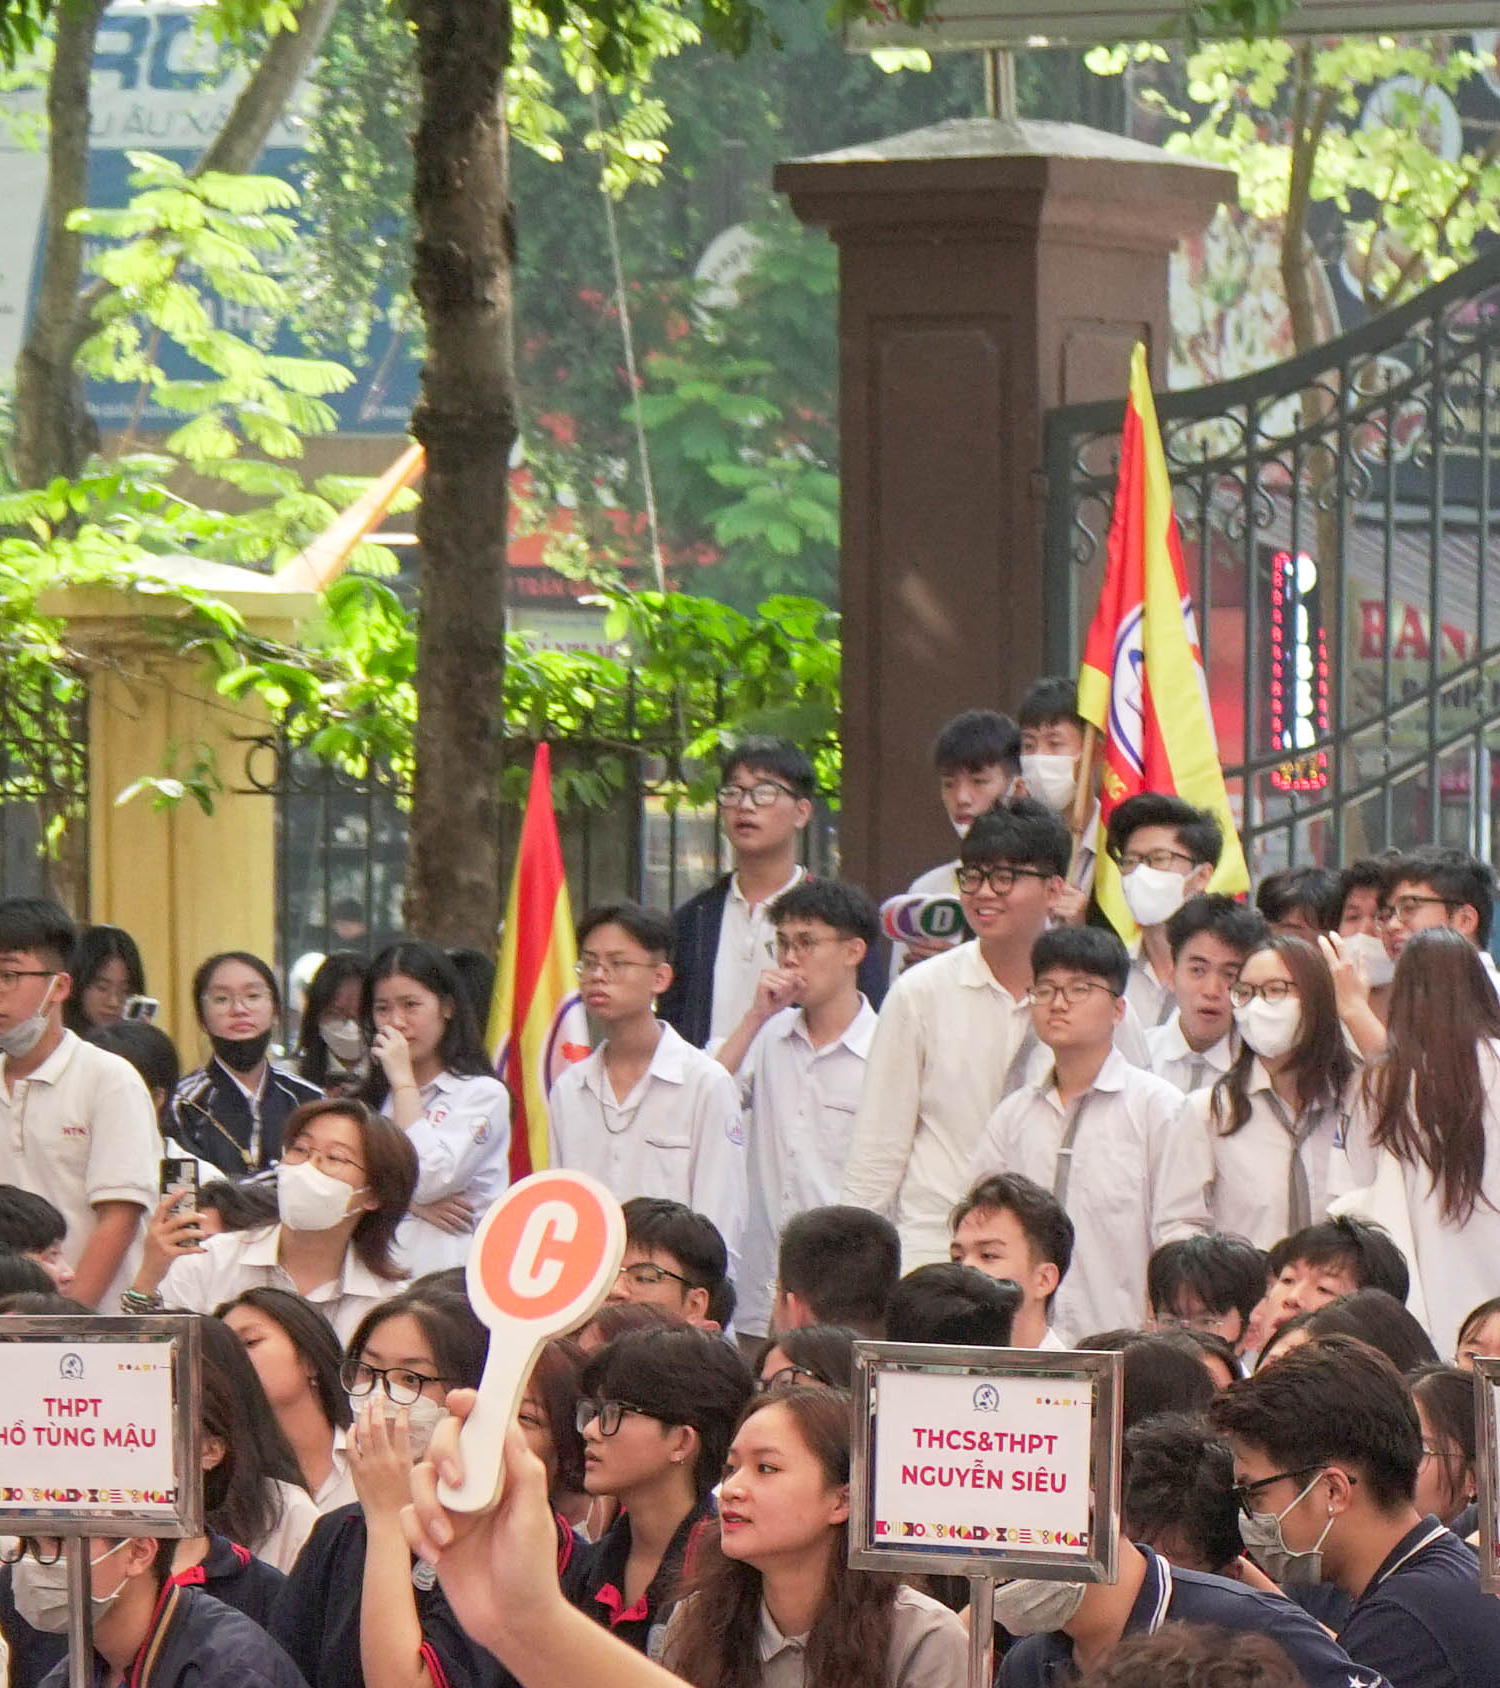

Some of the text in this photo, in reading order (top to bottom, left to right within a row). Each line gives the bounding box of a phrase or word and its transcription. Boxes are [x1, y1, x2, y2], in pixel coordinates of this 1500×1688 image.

[509, 1200, 578, 1298] C
[43, 1398, 102, 1417] THPT
[33, 1422, 96, 1447] TÙNG
[103, 1423, 157, 1453] MẬU
[912, 1428, 1058, 1455] THCS&THPT
[901, 1459, 1067, 1493] NGUYỄN SIÊU
